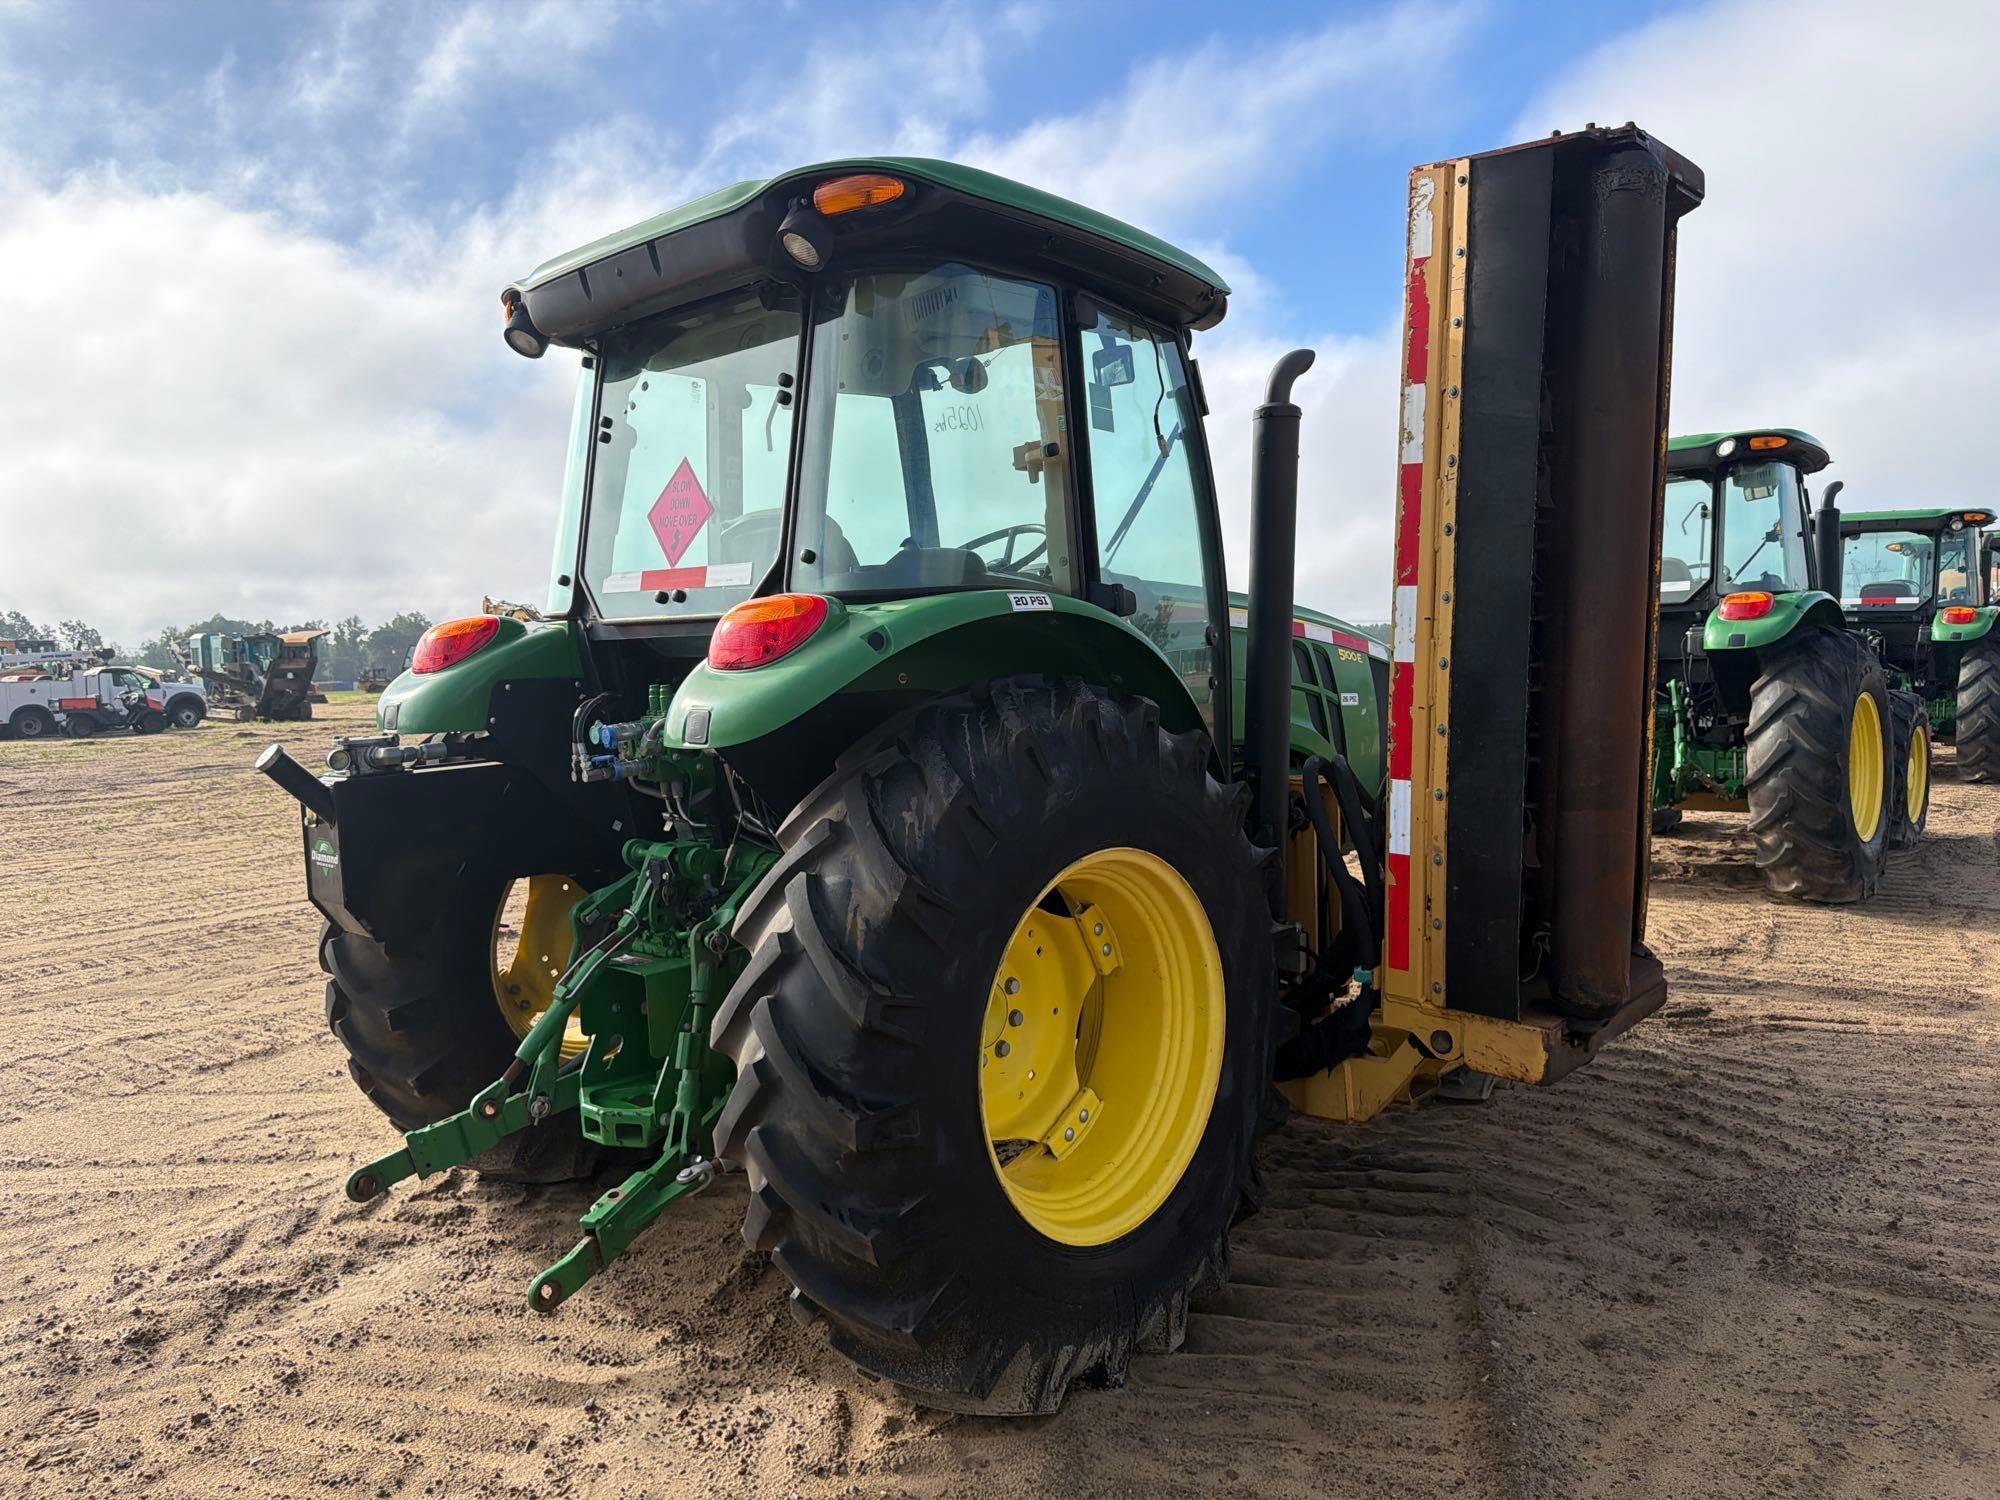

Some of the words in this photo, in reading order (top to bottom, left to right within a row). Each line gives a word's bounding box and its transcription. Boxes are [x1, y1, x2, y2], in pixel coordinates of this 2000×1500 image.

[672, 480, 692, 493] SLOW
[670, 498, 690, 511] DOWN
[659, 516, 679, 529] MOVE
[679, 513, 697, 527] OVER
[1013, 596, 1028, 606] 20
[1029, 596, 1049, 606] PSI
[311, 849, 339, 865] Diamond
